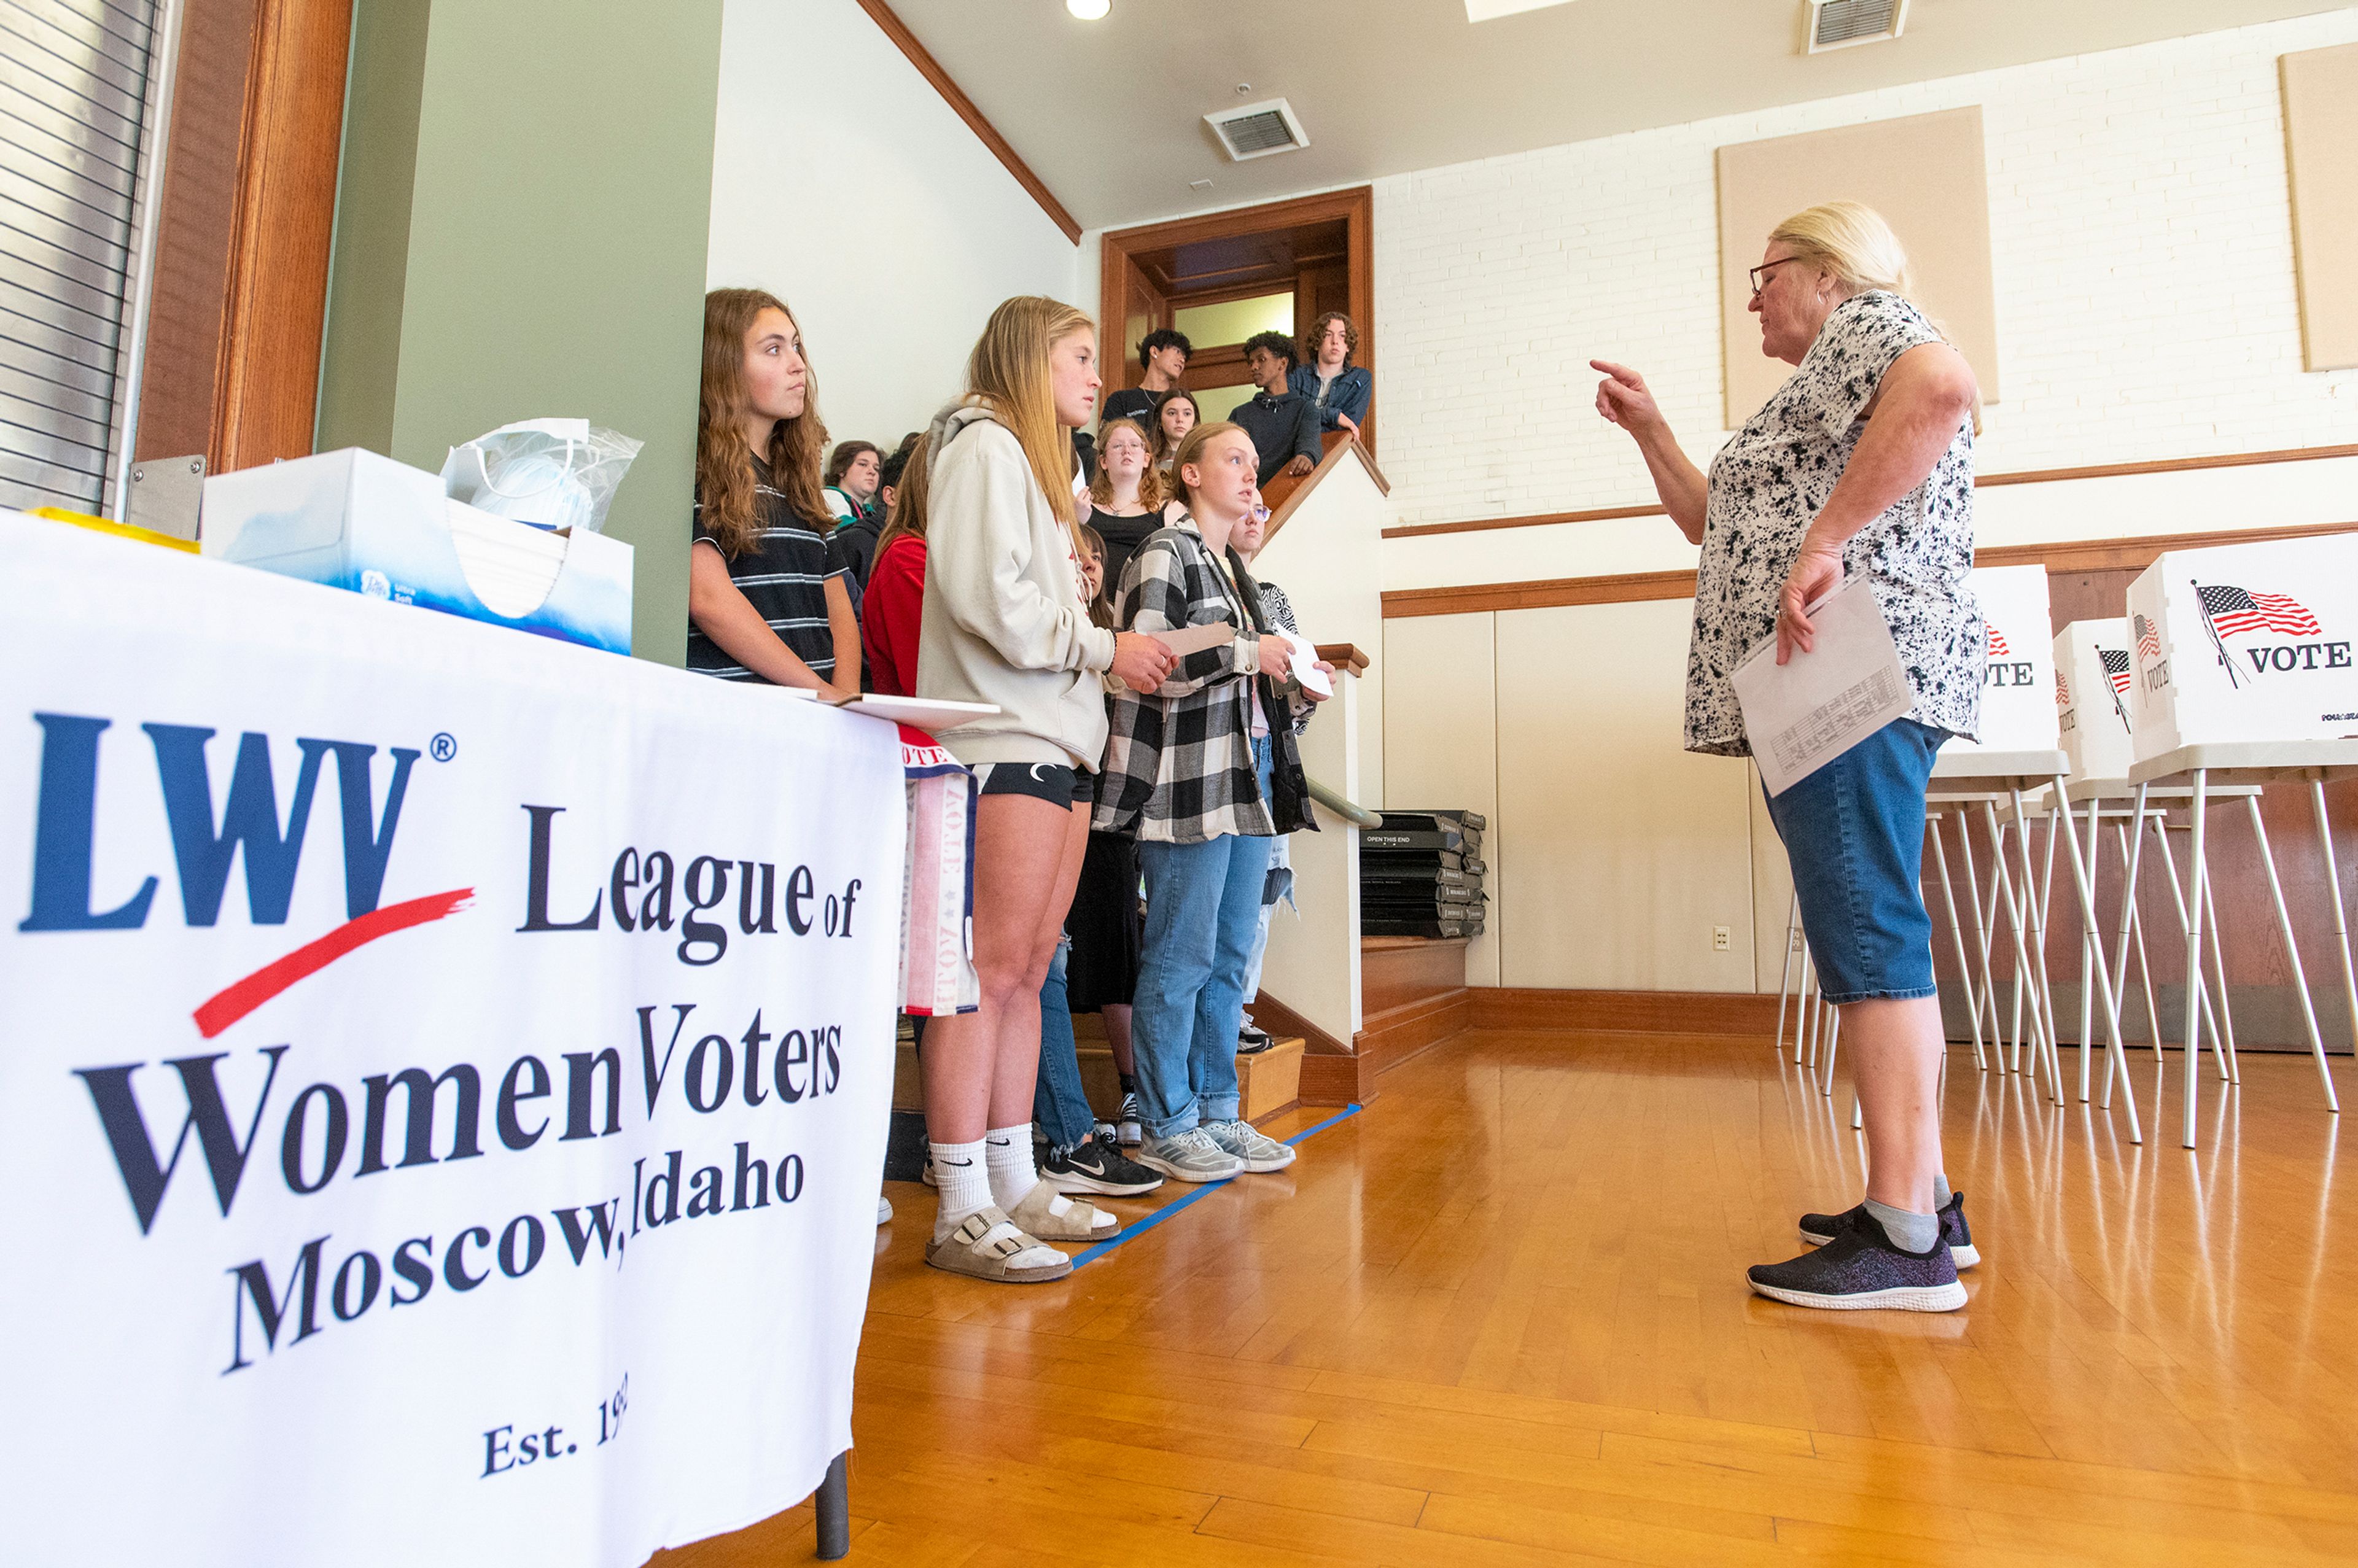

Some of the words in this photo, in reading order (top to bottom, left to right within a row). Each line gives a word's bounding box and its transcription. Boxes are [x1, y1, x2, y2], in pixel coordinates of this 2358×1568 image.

[1983, 662, 2034, 686] TE
[2147, 659, 2169, 693] VOTE
[2247, 642, 2352, 673] VOTE
[902, 747, 947, 766] OTE
[18, 711, 421, 933] LWV
[515, 804, 814, 966] League
[824, 879, 862, 938] of
[69, 1044, 622, 1236] Women
[636, 1003, 842, 1122] Voters
[220, 1197, 625, 1376] Moscow,
[630, 1141, 804, 1240] Idaho
[480, 1423, 578, 1479] Est.
